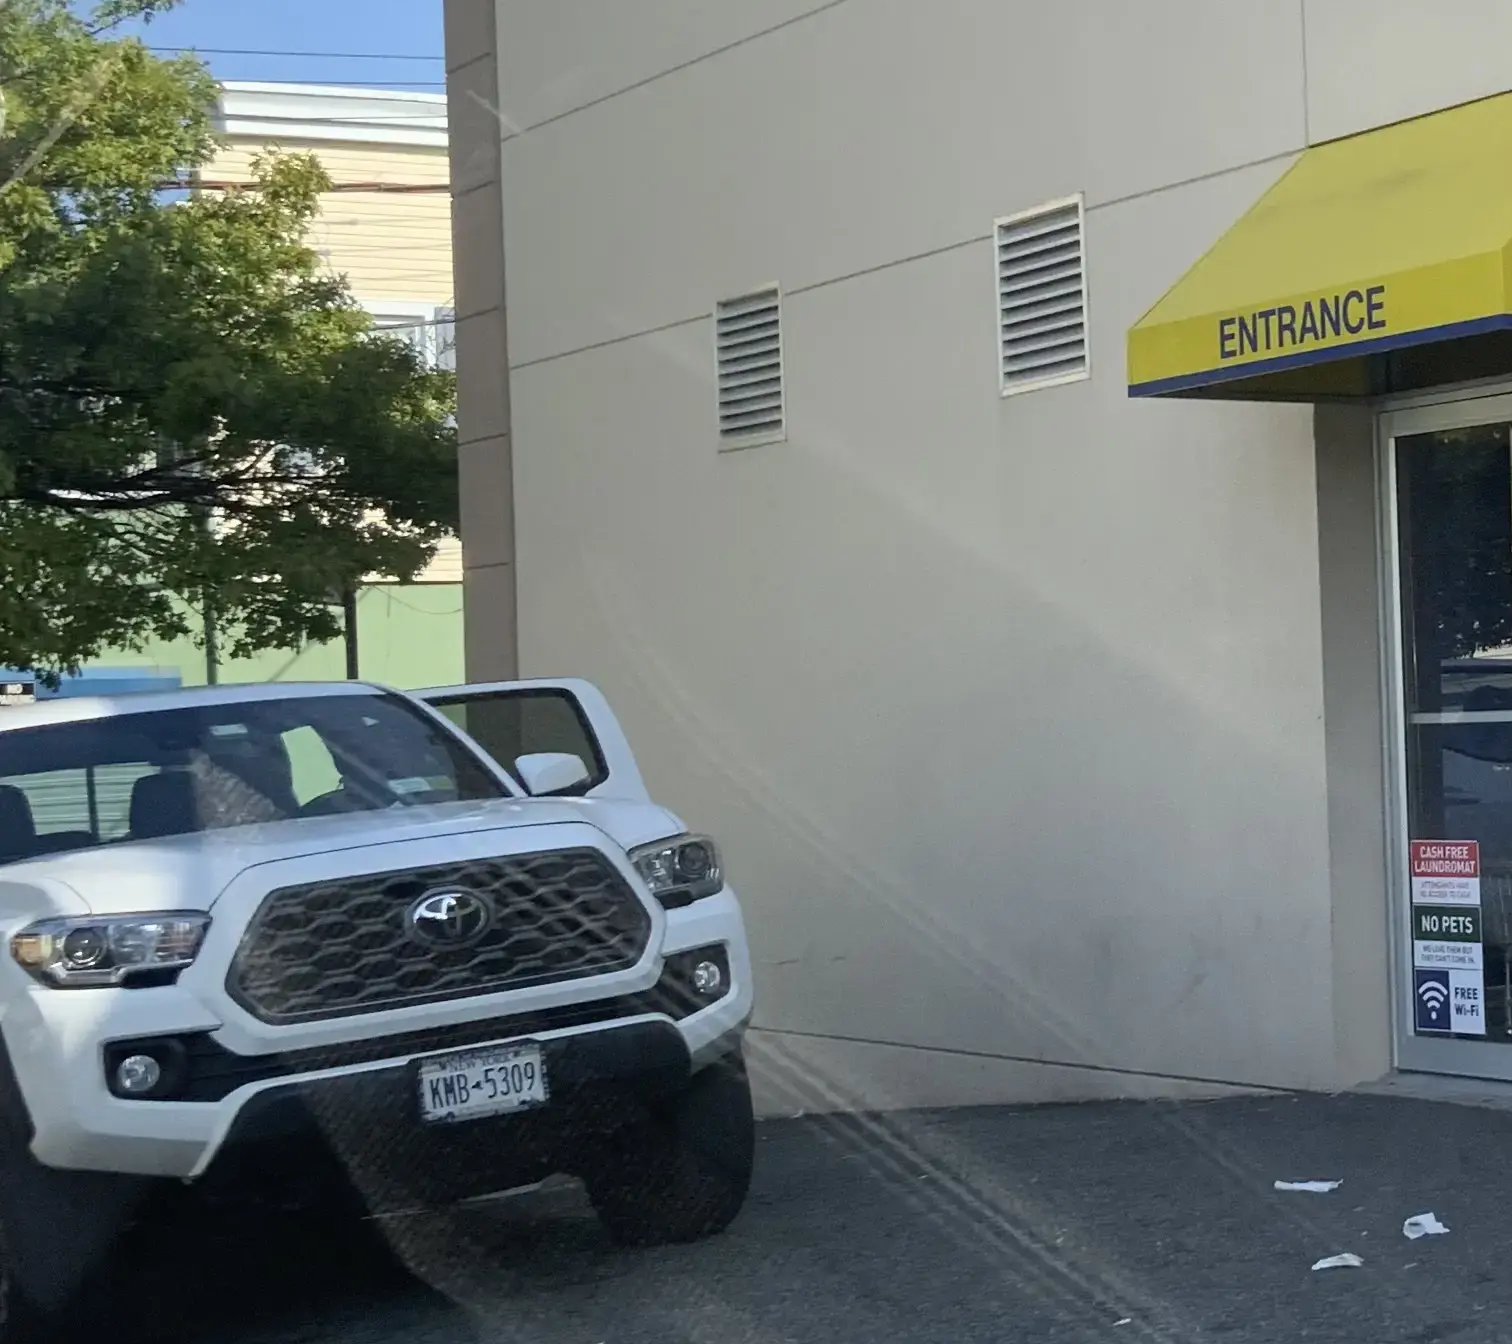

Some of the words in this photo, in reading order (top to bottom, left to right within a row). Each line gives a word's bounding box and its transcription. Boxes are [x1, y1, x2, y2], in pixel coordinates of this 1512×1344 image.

[1219, 285, 1386, 359] ENTRANCE
[1419, 846, 1444, 859] CASH
[1444, 846, 1469, 859] FREE
[1414, 860, 1476, 874] LAUNDROMAT
[1421, 915, 1439, 932] NO
[1441, 916, 1474, 934] PETS
[1454, 986, 1479, 1001] FREE
[1454, 1003, 1479, 1017] Wi-Fi
